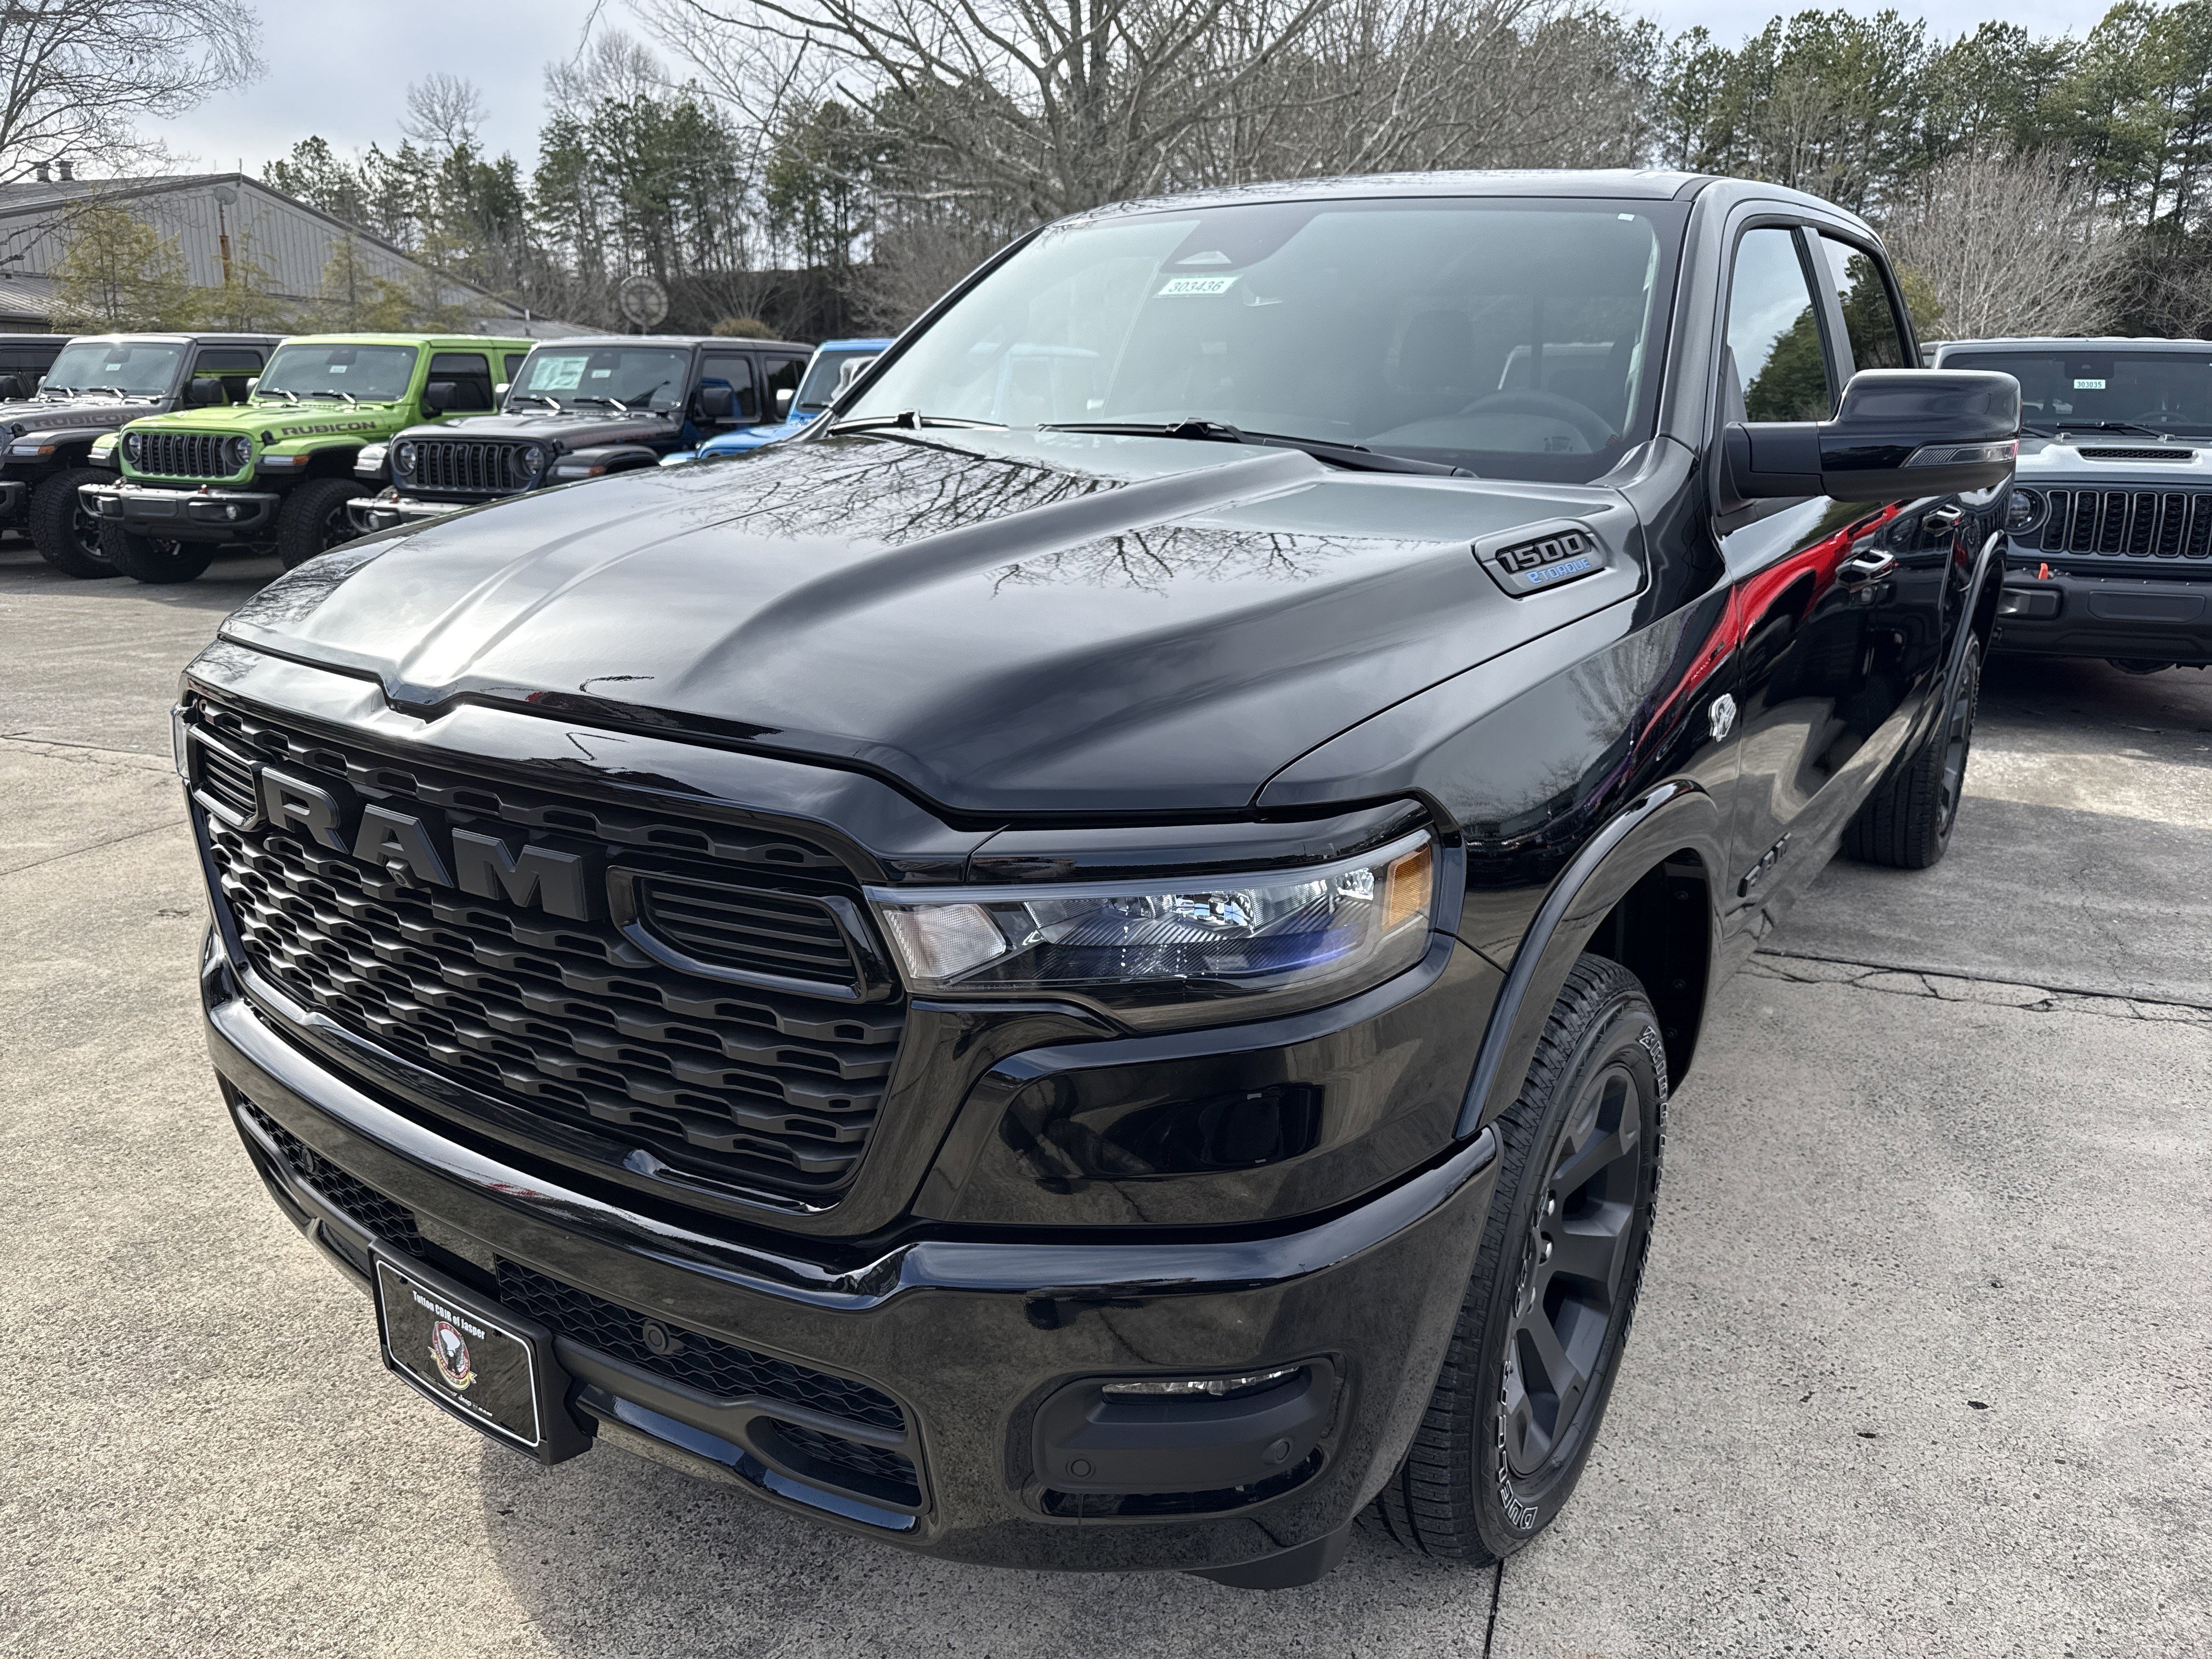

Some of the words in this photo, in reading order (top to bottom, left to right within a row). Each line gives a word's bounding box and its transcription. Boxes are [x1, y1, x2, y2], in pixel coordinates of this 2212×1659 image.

[1168, 280, 1224, 293] 303436
[33, 414, 137, 427] RUBICON
[281, 421, 377, 436] RUBICON
[1498, 534, 1585, 571] 1500
[262, 766, 589, 922] RAM
[413, 1290, 435, 1312] Tutton
[435, 1304, 452, 1322] CDJR
[453, 1316, 460, 1327] of
[461, 1318, 485, 1340] Jasper
